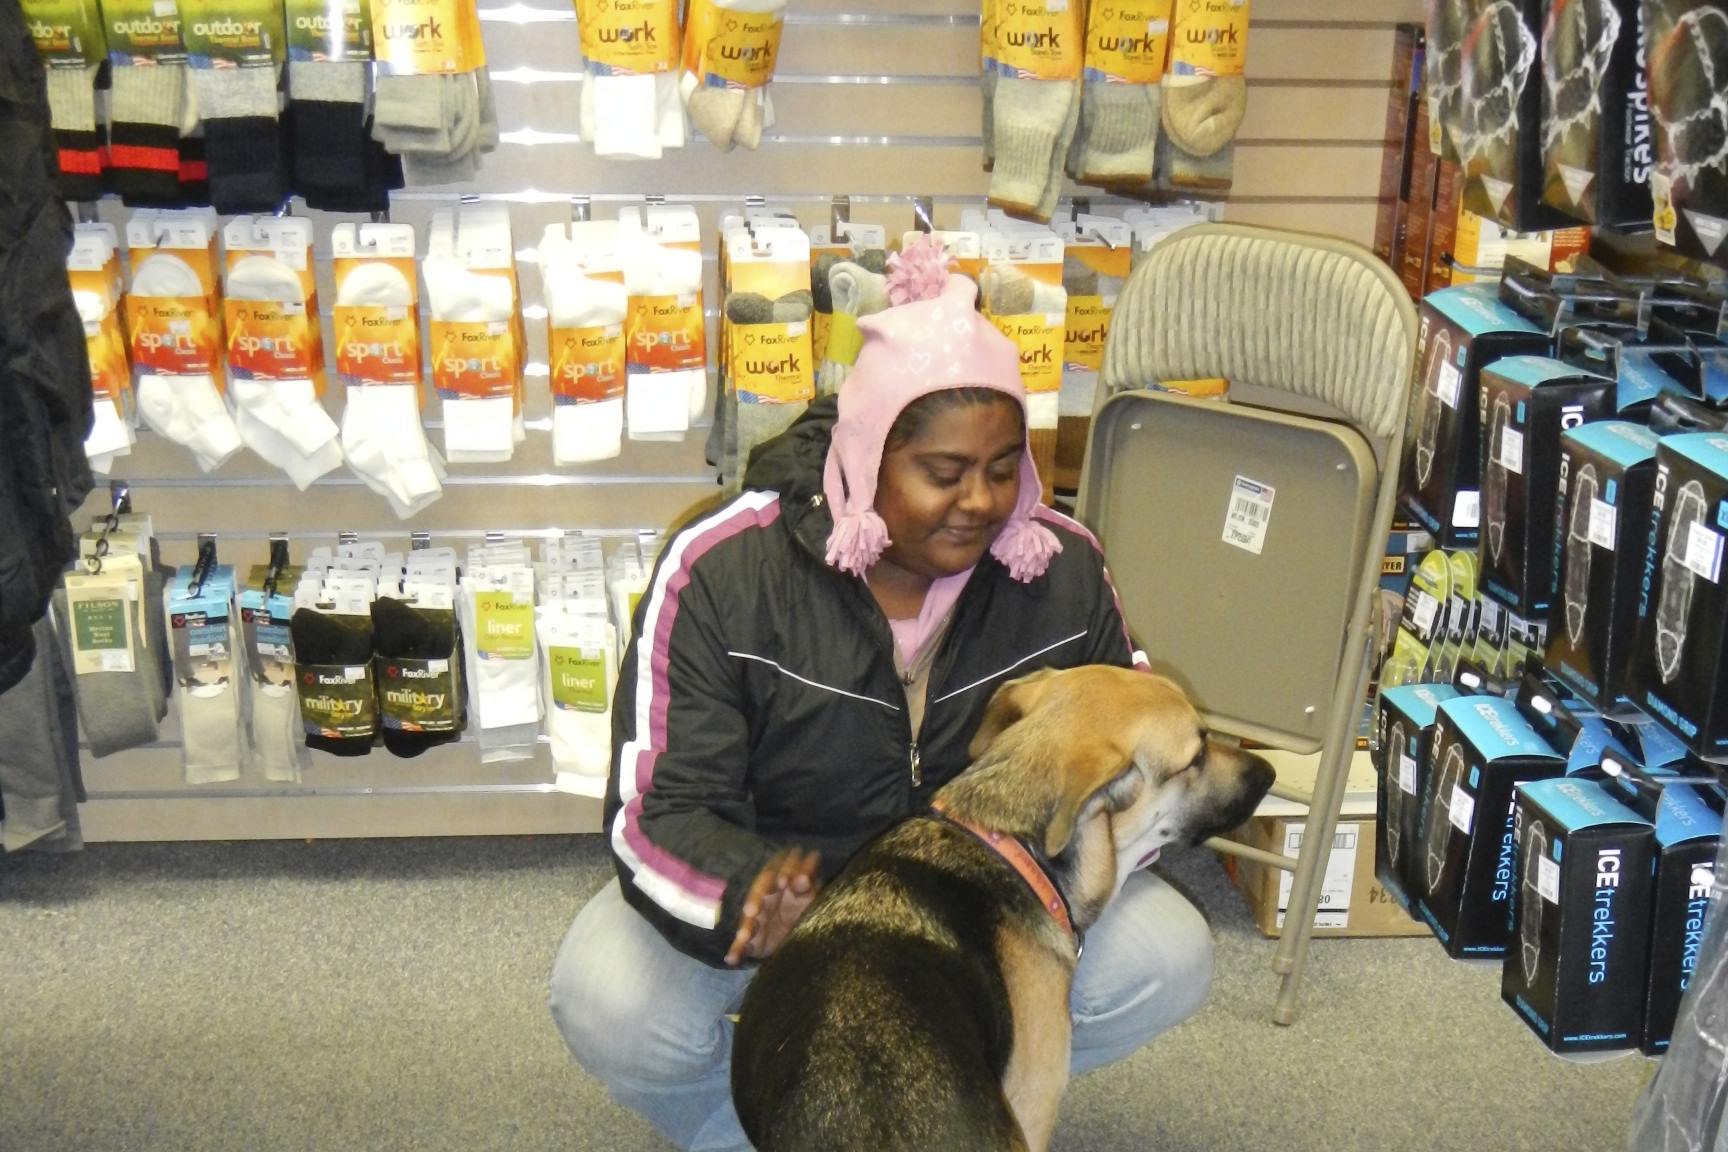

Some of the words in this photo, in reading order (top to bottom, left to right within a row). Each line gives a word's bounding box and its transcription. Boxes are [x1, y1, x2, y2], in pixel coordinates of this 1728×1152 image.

[114, 17, 181, 34] outdoor
[193, 18, 262, 35] outdoor
[383, 16, 443, 39] work
[598, 20, 656, 43] work
[1187, 22, 1238, 44] work
[1007, 27, 1060, 48] work
[1099, 32, 1154, 53] work
[721, 40, 773, 60] work
[153, 308, 193, 318] FoxRiver
[253, 310, 295, 320] FoxRiver
[653, 306, 693, 316] FoxRiver
[361, 317, 401, 327] FoxRiver
[1017, 325, 1054, 335] FoxRiver
[139, 332, 197, 354] sport
[238, 335, 297, 358] sport
[462, 332, 502, 342] FoxRiver
[581, 336, 618, 347] FoxRiver
[636, 330, 690, 352] sport
[761, 335, 799, 345] FoxRiver
[346, 341, 404, 364] sport
[1020, 344, 1053, 363] ork
[444, 355, 501, 378] sport
[563, 361, 615, 384] sport
[746, 353, 801, 374] work
[78, 601, 119, 609] FILSON
[487, 619, 523, 634] liner
[402, 668, 439, 679] FoxRiver
[562, 673, 596, 688] liner
[1589, 849, 1622, 984] ICEtrekkers
[1681, 862, 1713, 990] IEtrekkers
[1563, 1032, 1627, 1042] www.ICEtrekkers.com
